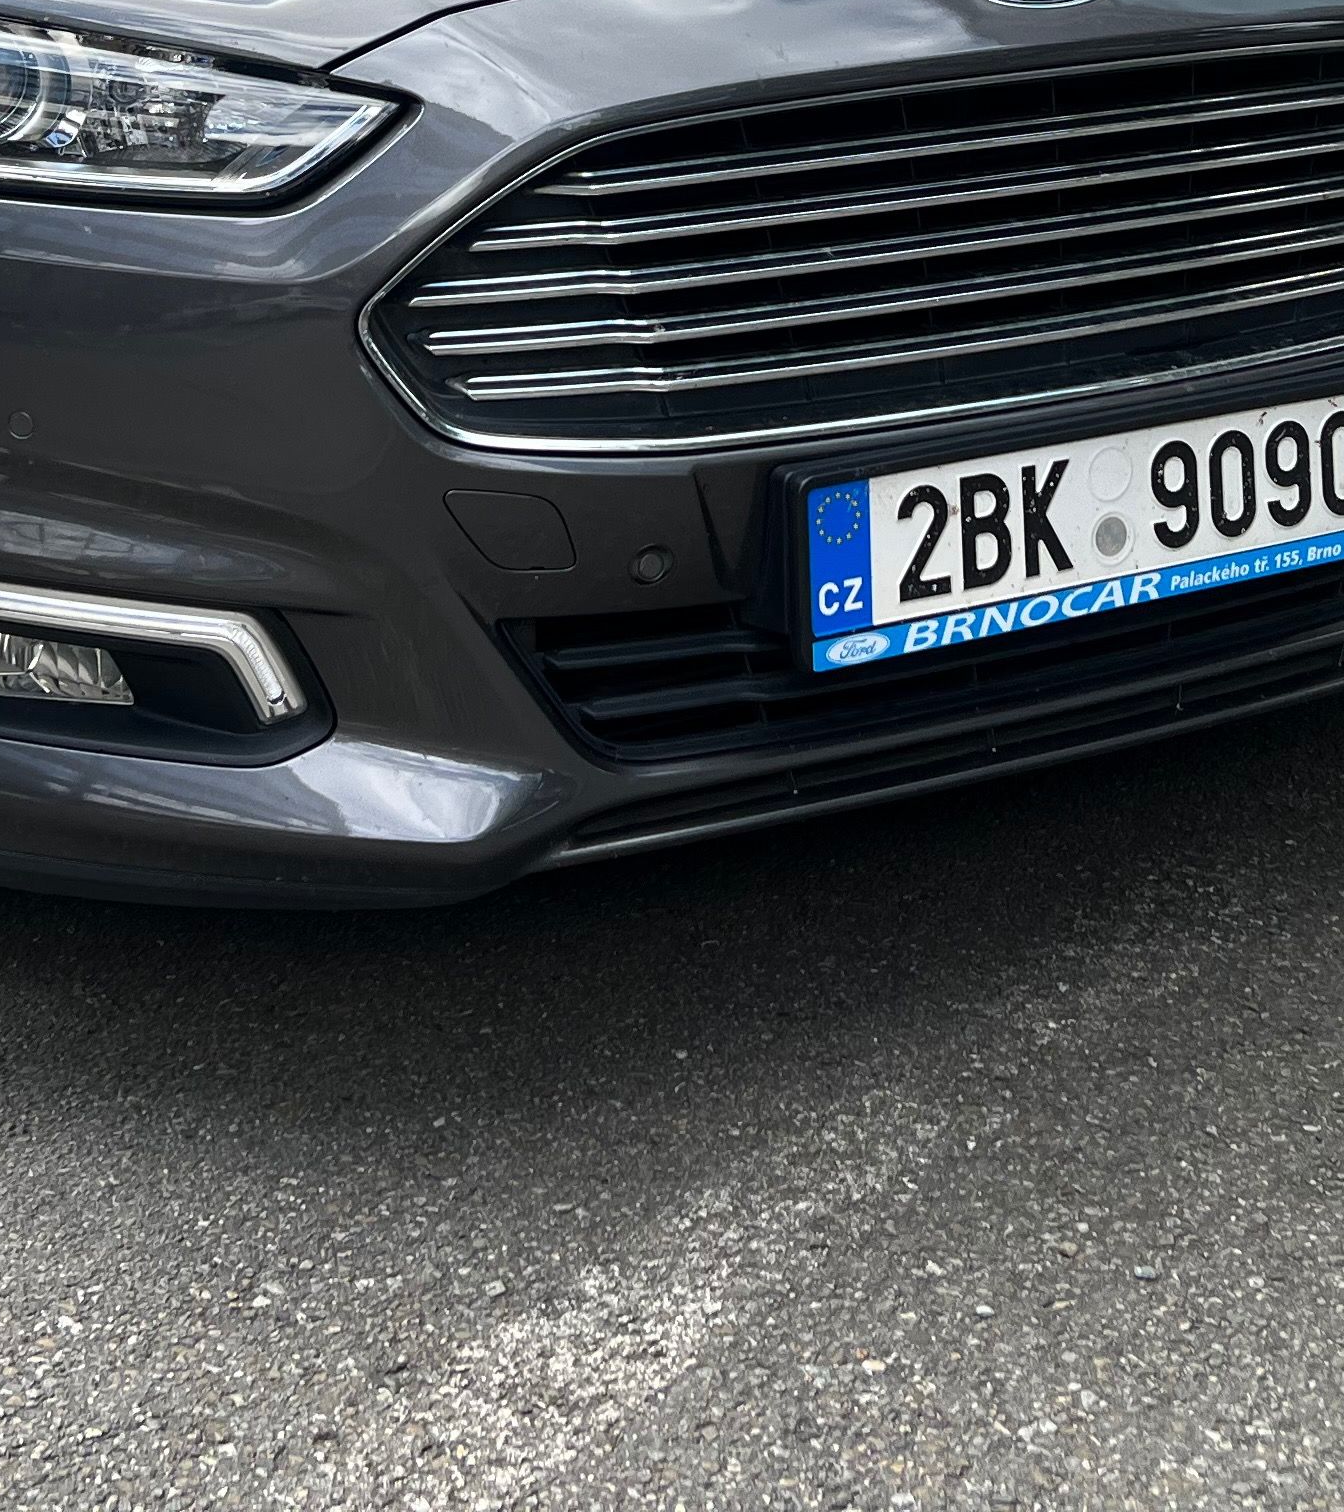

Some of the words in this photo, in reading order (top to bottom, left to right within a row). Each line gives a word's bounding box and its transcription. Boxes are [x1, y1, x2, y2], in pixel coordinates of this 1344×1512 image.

[897, 458, 1074, 603] 2BK
[818, 576, 864, 617] CZ
[839, 637, 877, 660] Ford
[903, 571, 1162, 654] BRNOCAR
[1170, 563, 1250, 591] Palackého
[1274, 549, 1303, 569] 155,
[1307, 543, 1342, 562] Brno
